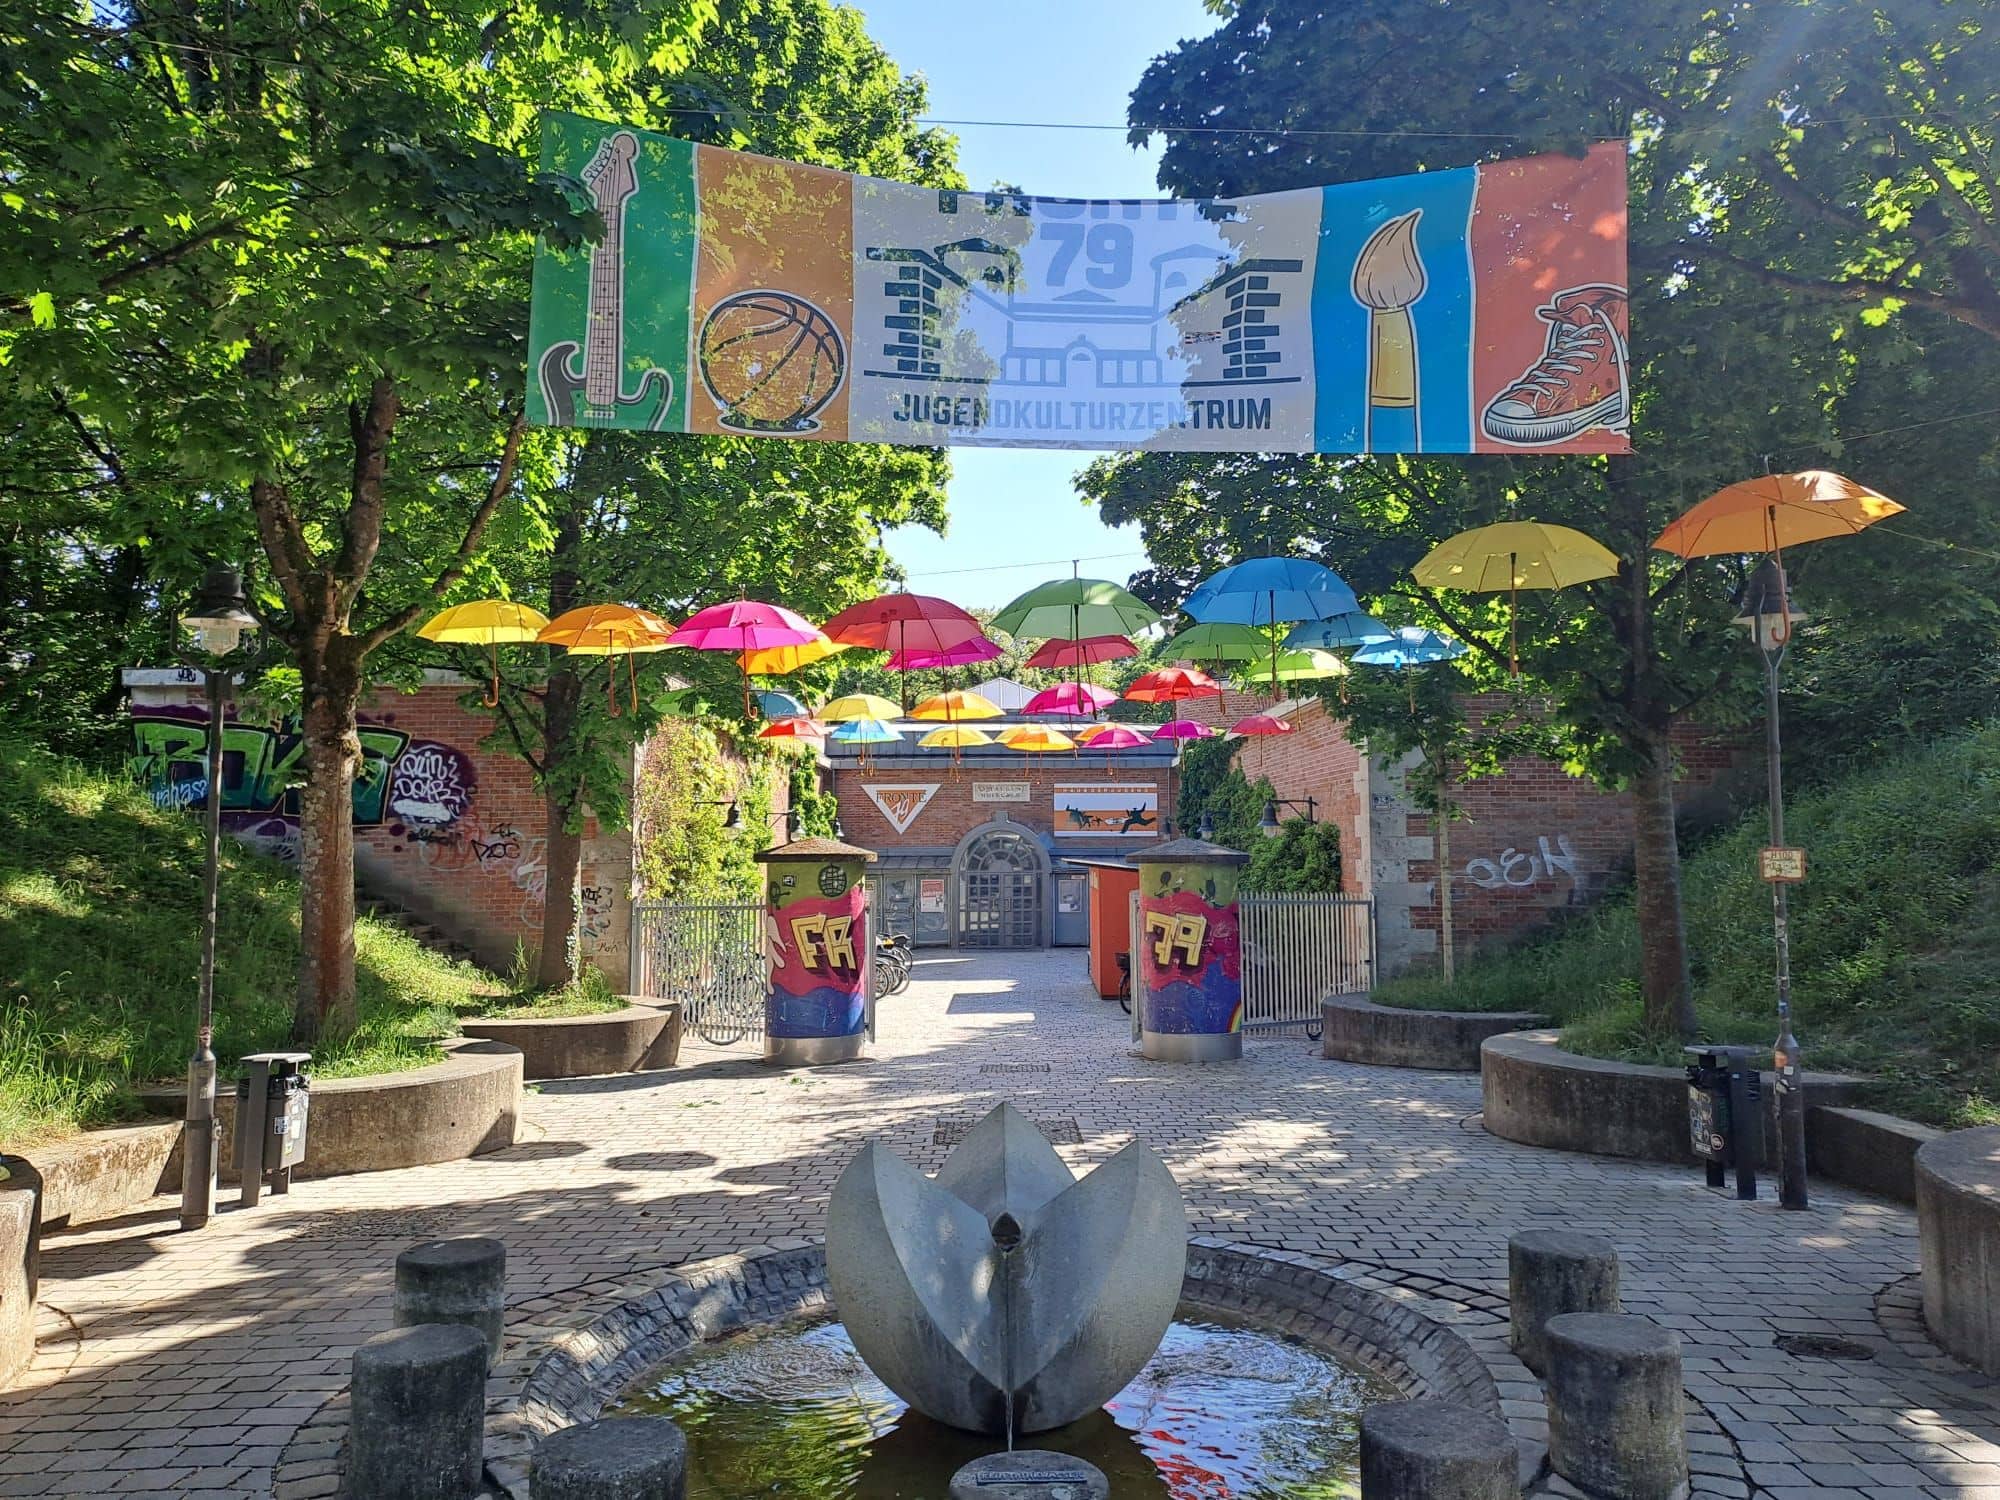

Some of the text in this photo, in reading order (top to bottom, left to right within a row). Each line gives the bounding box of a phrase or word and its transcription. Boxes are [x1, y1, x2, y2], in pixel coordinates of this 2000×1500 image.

[1040, 222, 1134, 290] 79
[892, 392, 1272, 431] JUGENDKULTURZENTRUM
[876, 791, 927, 803] FRONTE
[1146, 911, 1208, 967] 79
